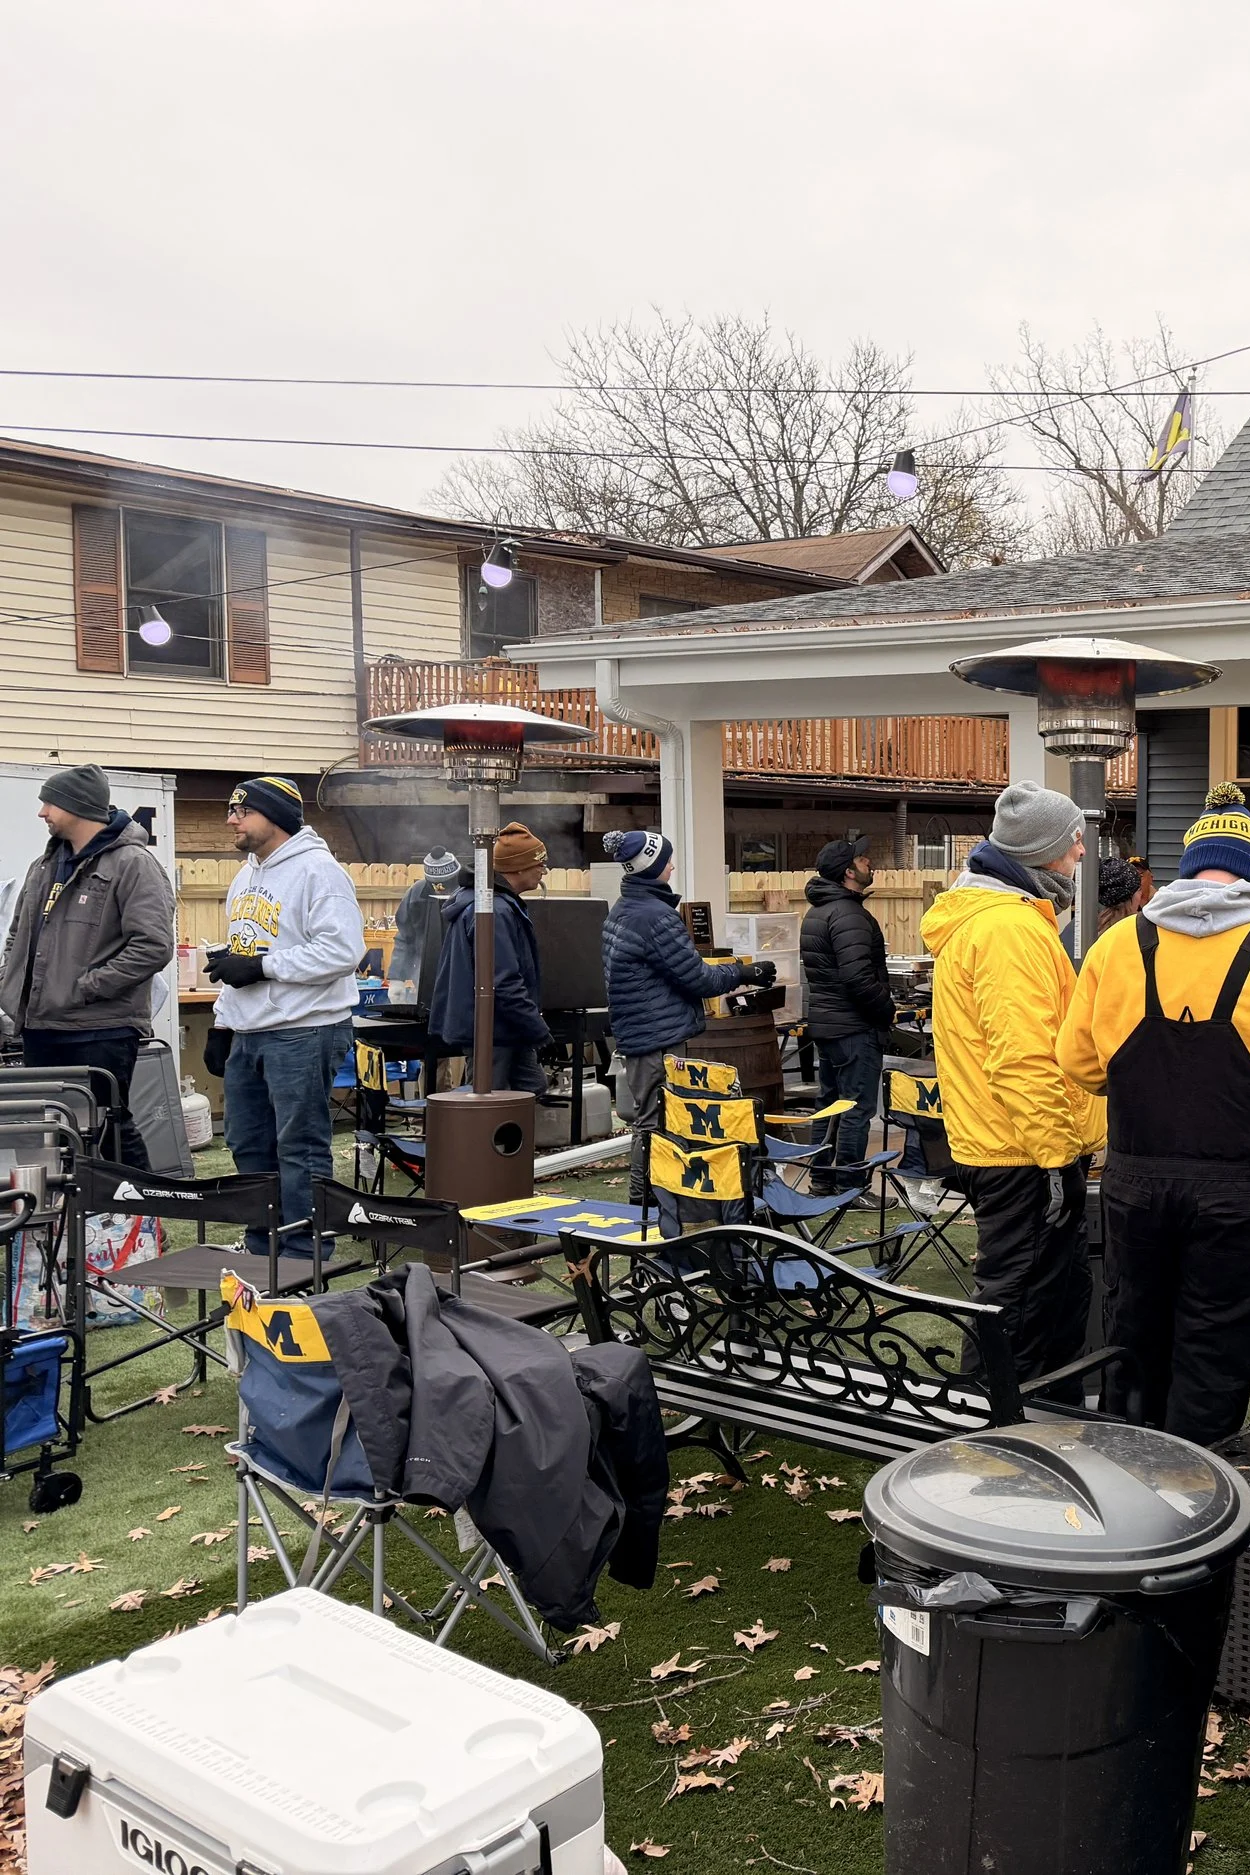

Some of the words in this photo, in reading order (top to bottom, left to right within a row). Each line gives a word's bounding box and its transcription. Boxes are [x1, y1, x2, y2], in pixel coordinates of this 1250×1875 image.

[687, 1065, 708, 1088] M
[916, 1081, 942, 1113] M
[684, 1103, 726, 1139] M
